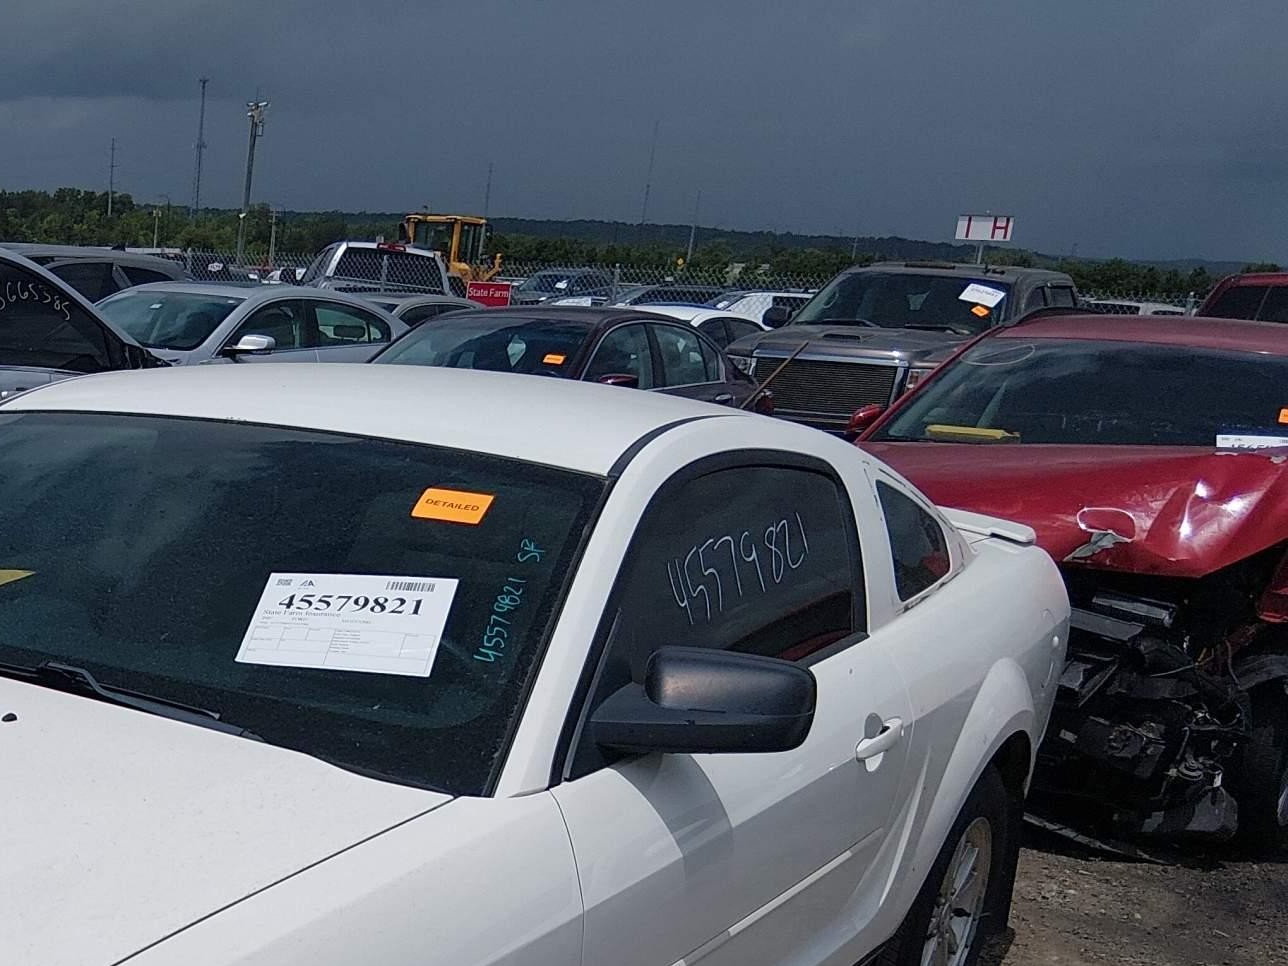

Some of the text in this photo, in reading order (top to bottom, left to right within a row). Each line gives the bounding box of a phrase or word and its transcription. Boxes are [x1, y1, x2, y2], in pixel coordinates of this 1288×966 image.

[991, 216, 1011, 240] H
[468, 288, 509, 298] State Farm
[425, 498, 480, 511] DETAILED
[667, 511, 809, 625] 45579821
[278, 593, 423, 616] 45579821
[473, 577, 527, 662] 45579821
